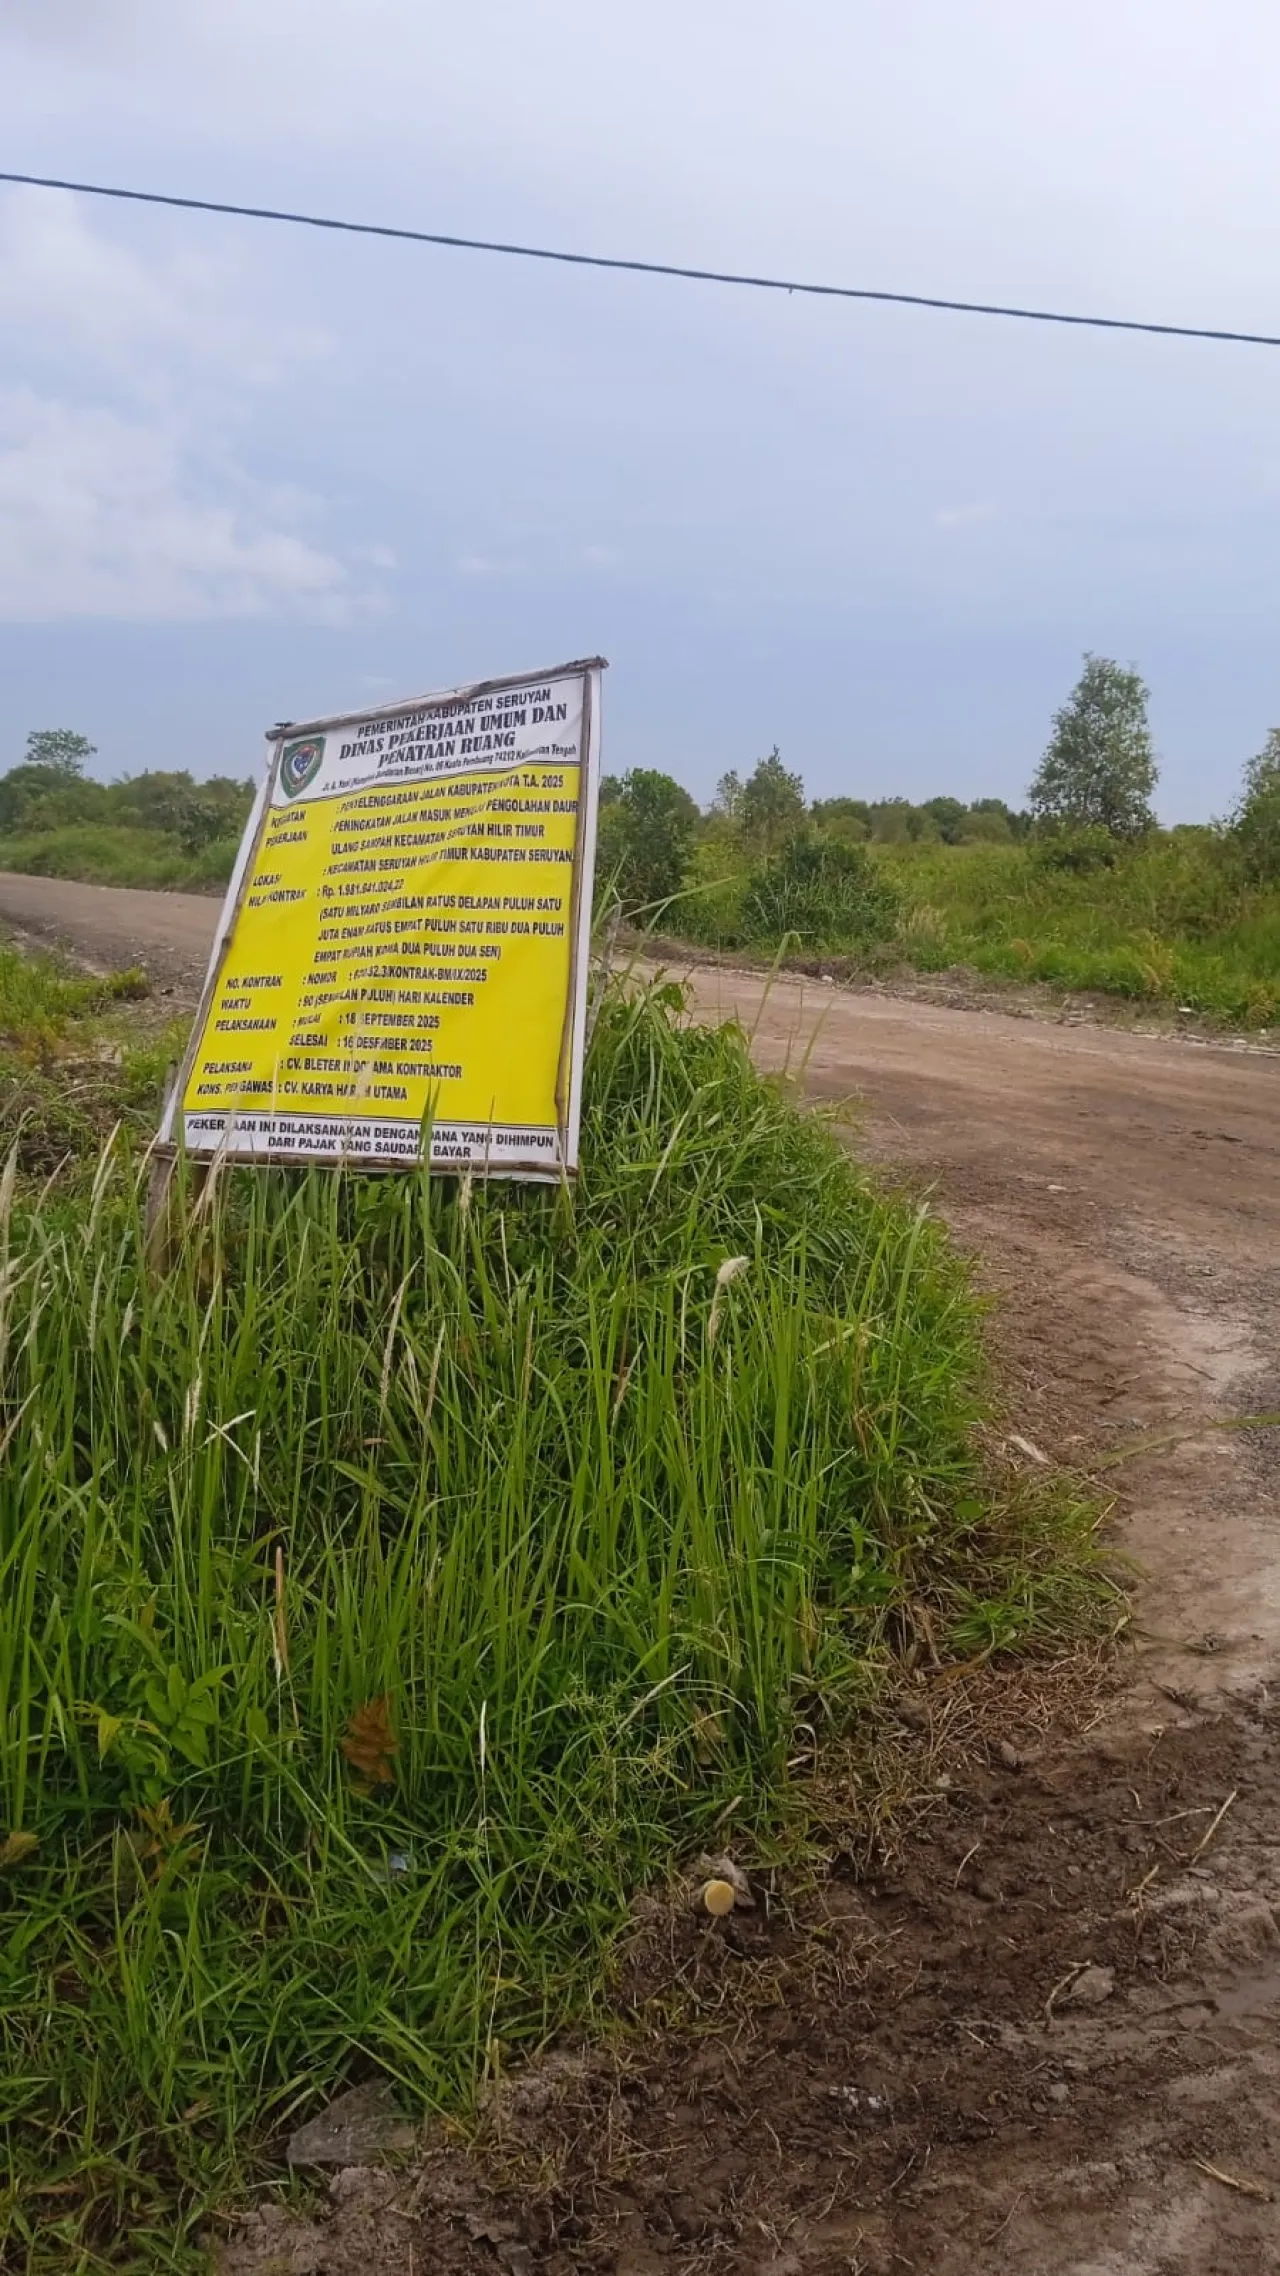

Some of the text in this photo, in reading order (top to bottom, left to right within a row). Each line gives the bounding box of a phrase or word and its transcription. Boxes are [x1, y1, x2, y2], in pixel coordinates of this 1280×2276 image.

[357, 711, 424, 738] PEMERINTAH
[495, 688, 551, 709] SERUYAN
[339, 702, 567, 760] DINAS PEKERJAAN UMUM DAN
[377, 731, 515, 769] PENATAAN RUANG
[420, 787, 445, 800] JALAN
[523, 774, 539, 788] T.A.
[541, 774, 564, 789] 2025
[393, 810, 418, 825] JALAN
[420, 808, 451, 821] MASUK
[486, 798, 550, 813] PENGOLAHAN
[331, 841, 359, 855] ULANG
[394, 831, 446, 847] KECAMATAN
[487, 823, 512, 836] HILIR
[515, 824, 545, 837] TIMUR
[327, 859, 376, 875] KECAMATAN
[378, 856, 416, 871] SERUYAN
[440, 847, 468, 861] TIMUR
[470, 848, 526, 862] KABUPATEN
[426, 895, 456, 908] RATUS
[458, 895, 500, 910] DELAPAN
[503, 897, 534, 911] PULUH
[537, 898, 562, 911] SATU
[318, 929, 339, 941] JUTA
[394, 918, 423, 933] EMPAT
[424, 919, 456, 932] PULUH
[459, 921, 483, 934] SATU
[486, 922, 508, 934] RIBU
[511, 921, 530, 934] DUA
[532, 922, 564, 936] PULUH
[314, 949, 342, 963] EMPAT
[401, 942, 420, 955] DUA
[424, 943, 456, 957] PULUH
[458, 944, 477, 957] DUA
[479, 945, 501, 961] SEN)
[398, 990, 421, 1004] HARI
[424, 992, 474, 1006] KALENDER
[215, 1018, 277, 1031] PELAKSANAAN
[345, 1012, 356, 1024] 18
[417, 1014, 440, 1029] 2025
[289, 1033, 328, 1047] SELESAI
[410, 1039, 433, 1052] 2025
[287, 1057, 301, 1070] CV.
[304, 1058, 340, 1072] BLETER
[396, 1062, 462, 1078] KONTRAKTOR
[284, 1081, 298, 1093] CV.
[301, 1082, 333, 1095] KARYA
[374, 1086, 407, 1100] UTAMA
[187, 1119, 256, 1132] PEKERAAN
[259, 1120, 276, 1132] INI
[279, 1121, 371, 1138] DILAKSANAKAN
[461, 1131, 492, 1144] YANG
[496, 1133, 554, 1148] DIHIMPUN
[268, 1137, 471, 1158] DARI PAJAK YANG SAUDAR BAYAR
